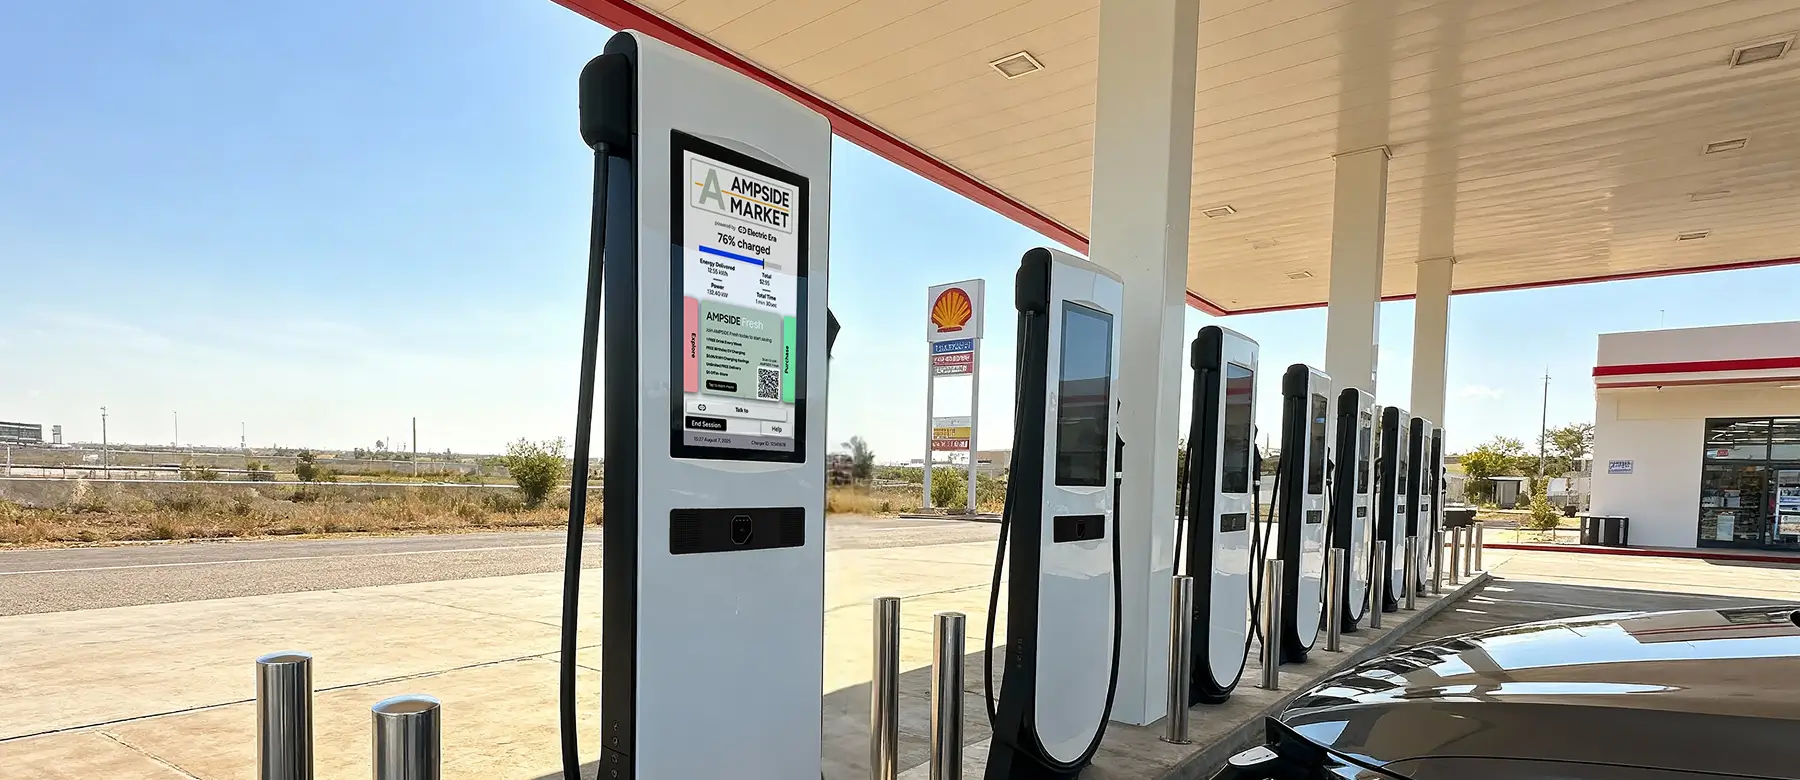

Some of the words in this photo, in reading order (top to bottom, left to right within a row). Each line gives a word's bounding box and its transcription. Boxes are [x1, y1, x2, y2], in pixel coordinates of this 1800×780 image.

[698, 168, 725, 211] A
[731, 176, 790, 208] AMPSIDE
[730, 197, 789, 228] MARKET
[714, 220, 730, 228] powered
[718, 232, 736, 246] 76%
[737, 239, 770, 255] charged
[748, 228, 767, 240] Electric
[768, 234, 777, 242] Era
[700, 258, 715, 267] Energy
[716, 262, 735, 271] Delivered
[706, 311, 740, 325] AMPSIDE
[742, 318, 764, 330] Fresh
